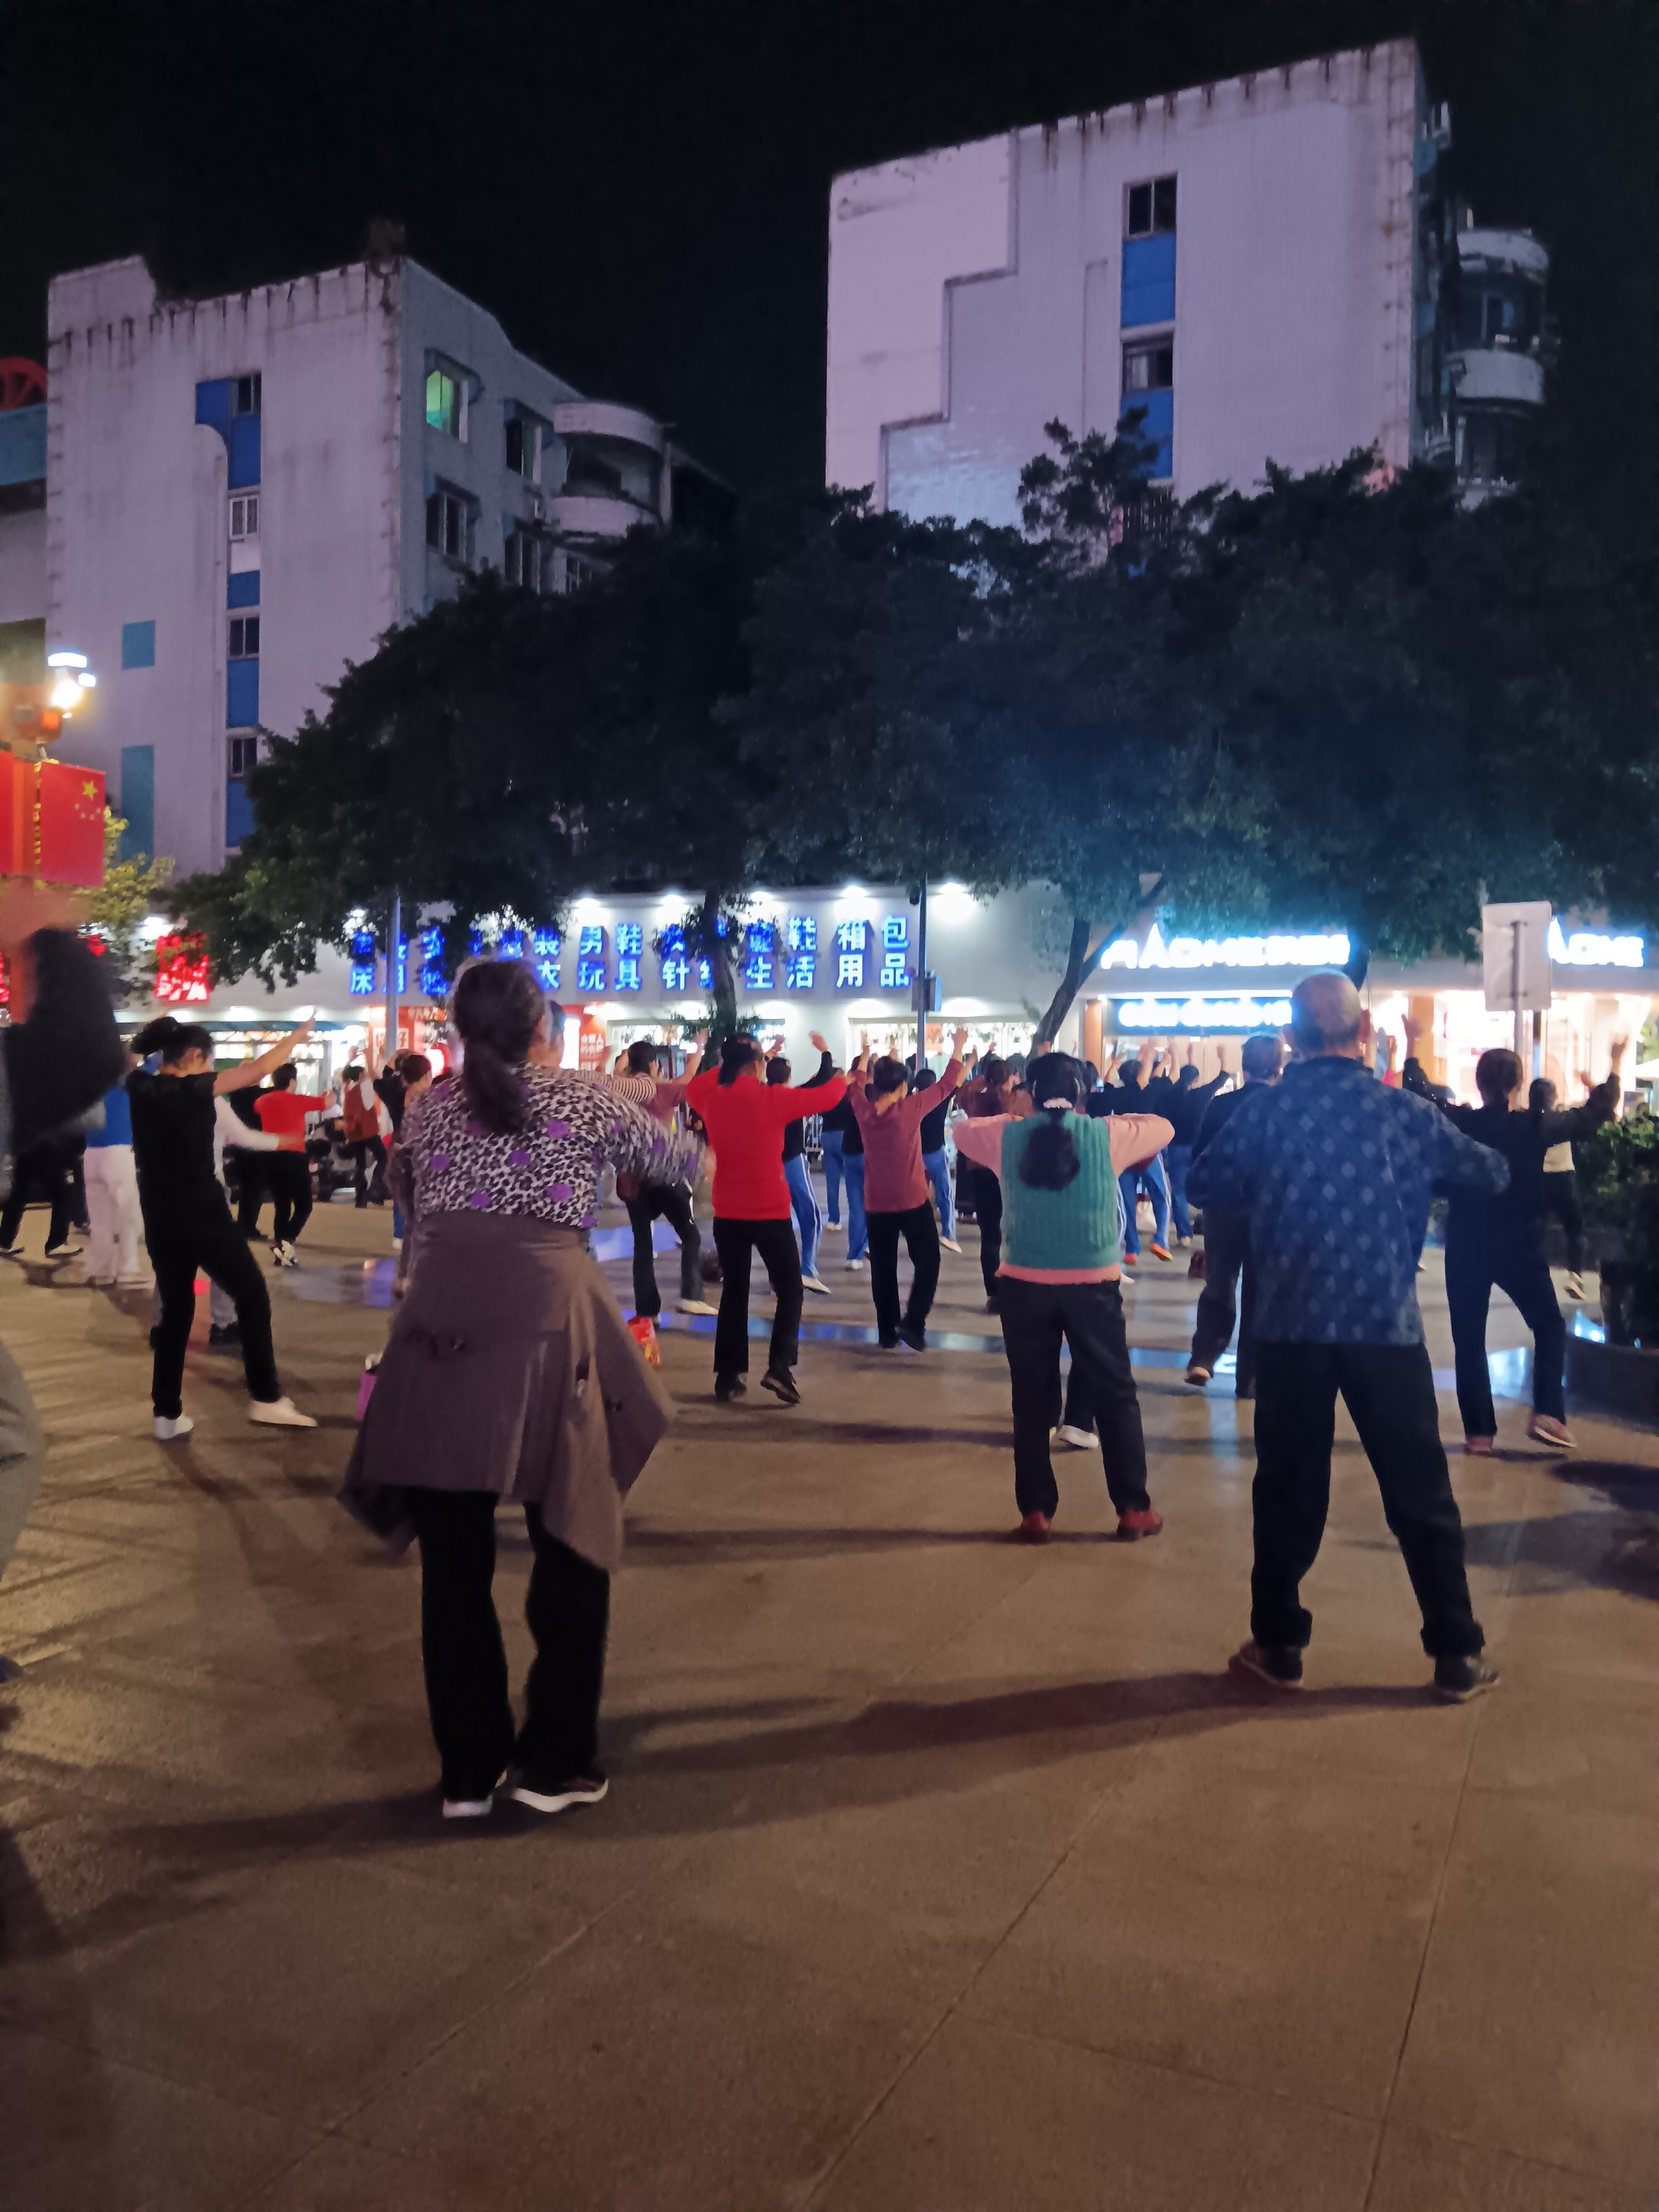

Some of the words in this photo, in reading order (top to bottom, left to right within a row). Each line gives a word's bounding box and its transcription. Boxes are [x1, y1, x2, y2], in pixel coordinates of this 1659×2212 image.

[580, 923, 643, 955] 男鞋
[837, 915, 910, 952] 箱包
[578, 959, 642, 991] 玩具
[746, 955, 815, 990] 生活
[836, 952, 910, 988] 用品
